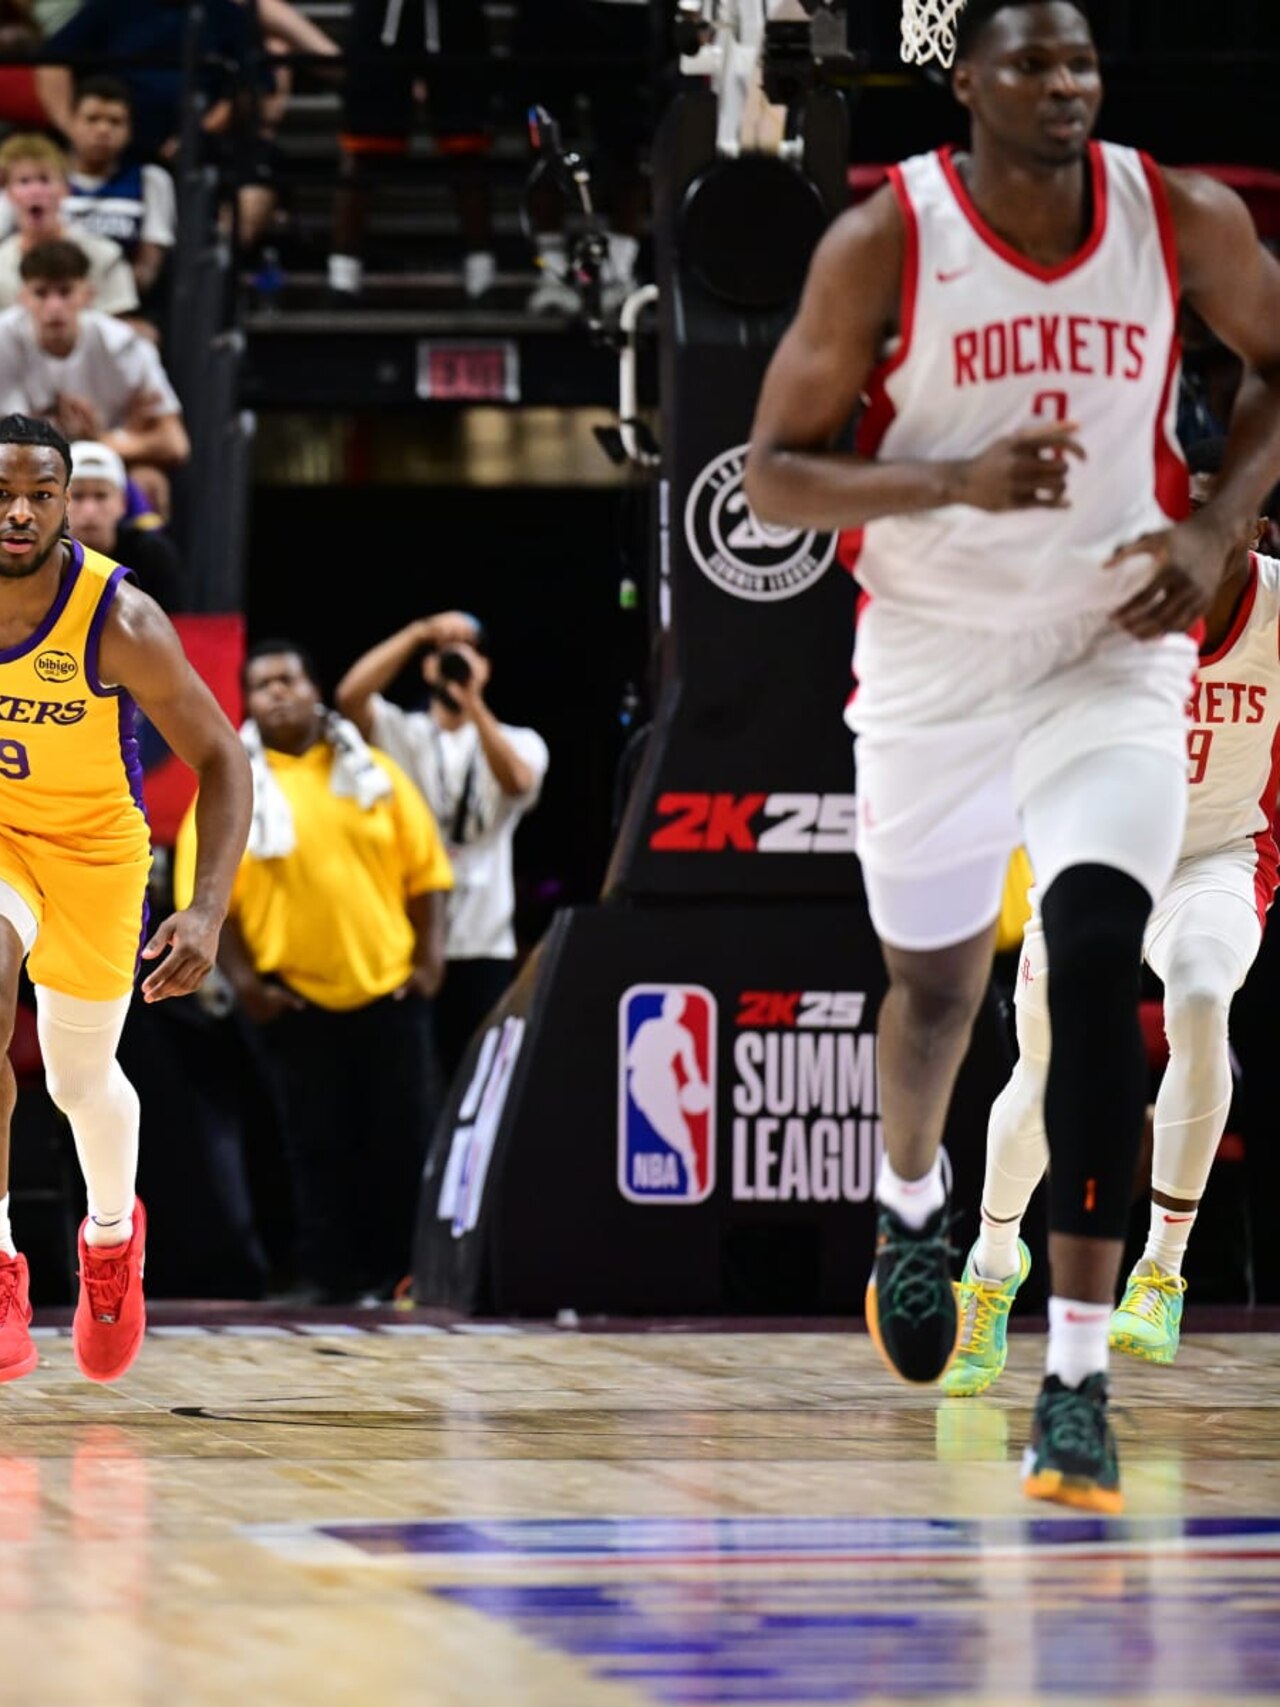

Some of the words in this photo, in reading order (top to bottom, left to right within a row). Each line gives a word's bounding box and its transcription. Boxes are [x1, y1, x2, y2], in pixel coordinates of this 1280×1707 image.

[953, 314, 1147, 388] ROCKETS
[38, 658, 76, 675] bibigo
[649, 793, 857, 853] 2K25
[735, 990, 867, 1028] 2K25
[732, 1030, 880, 1117] SUMM
[632, 1152, 679, 1190] NBA
[732, 1117, 884, 1202] LEAGU
